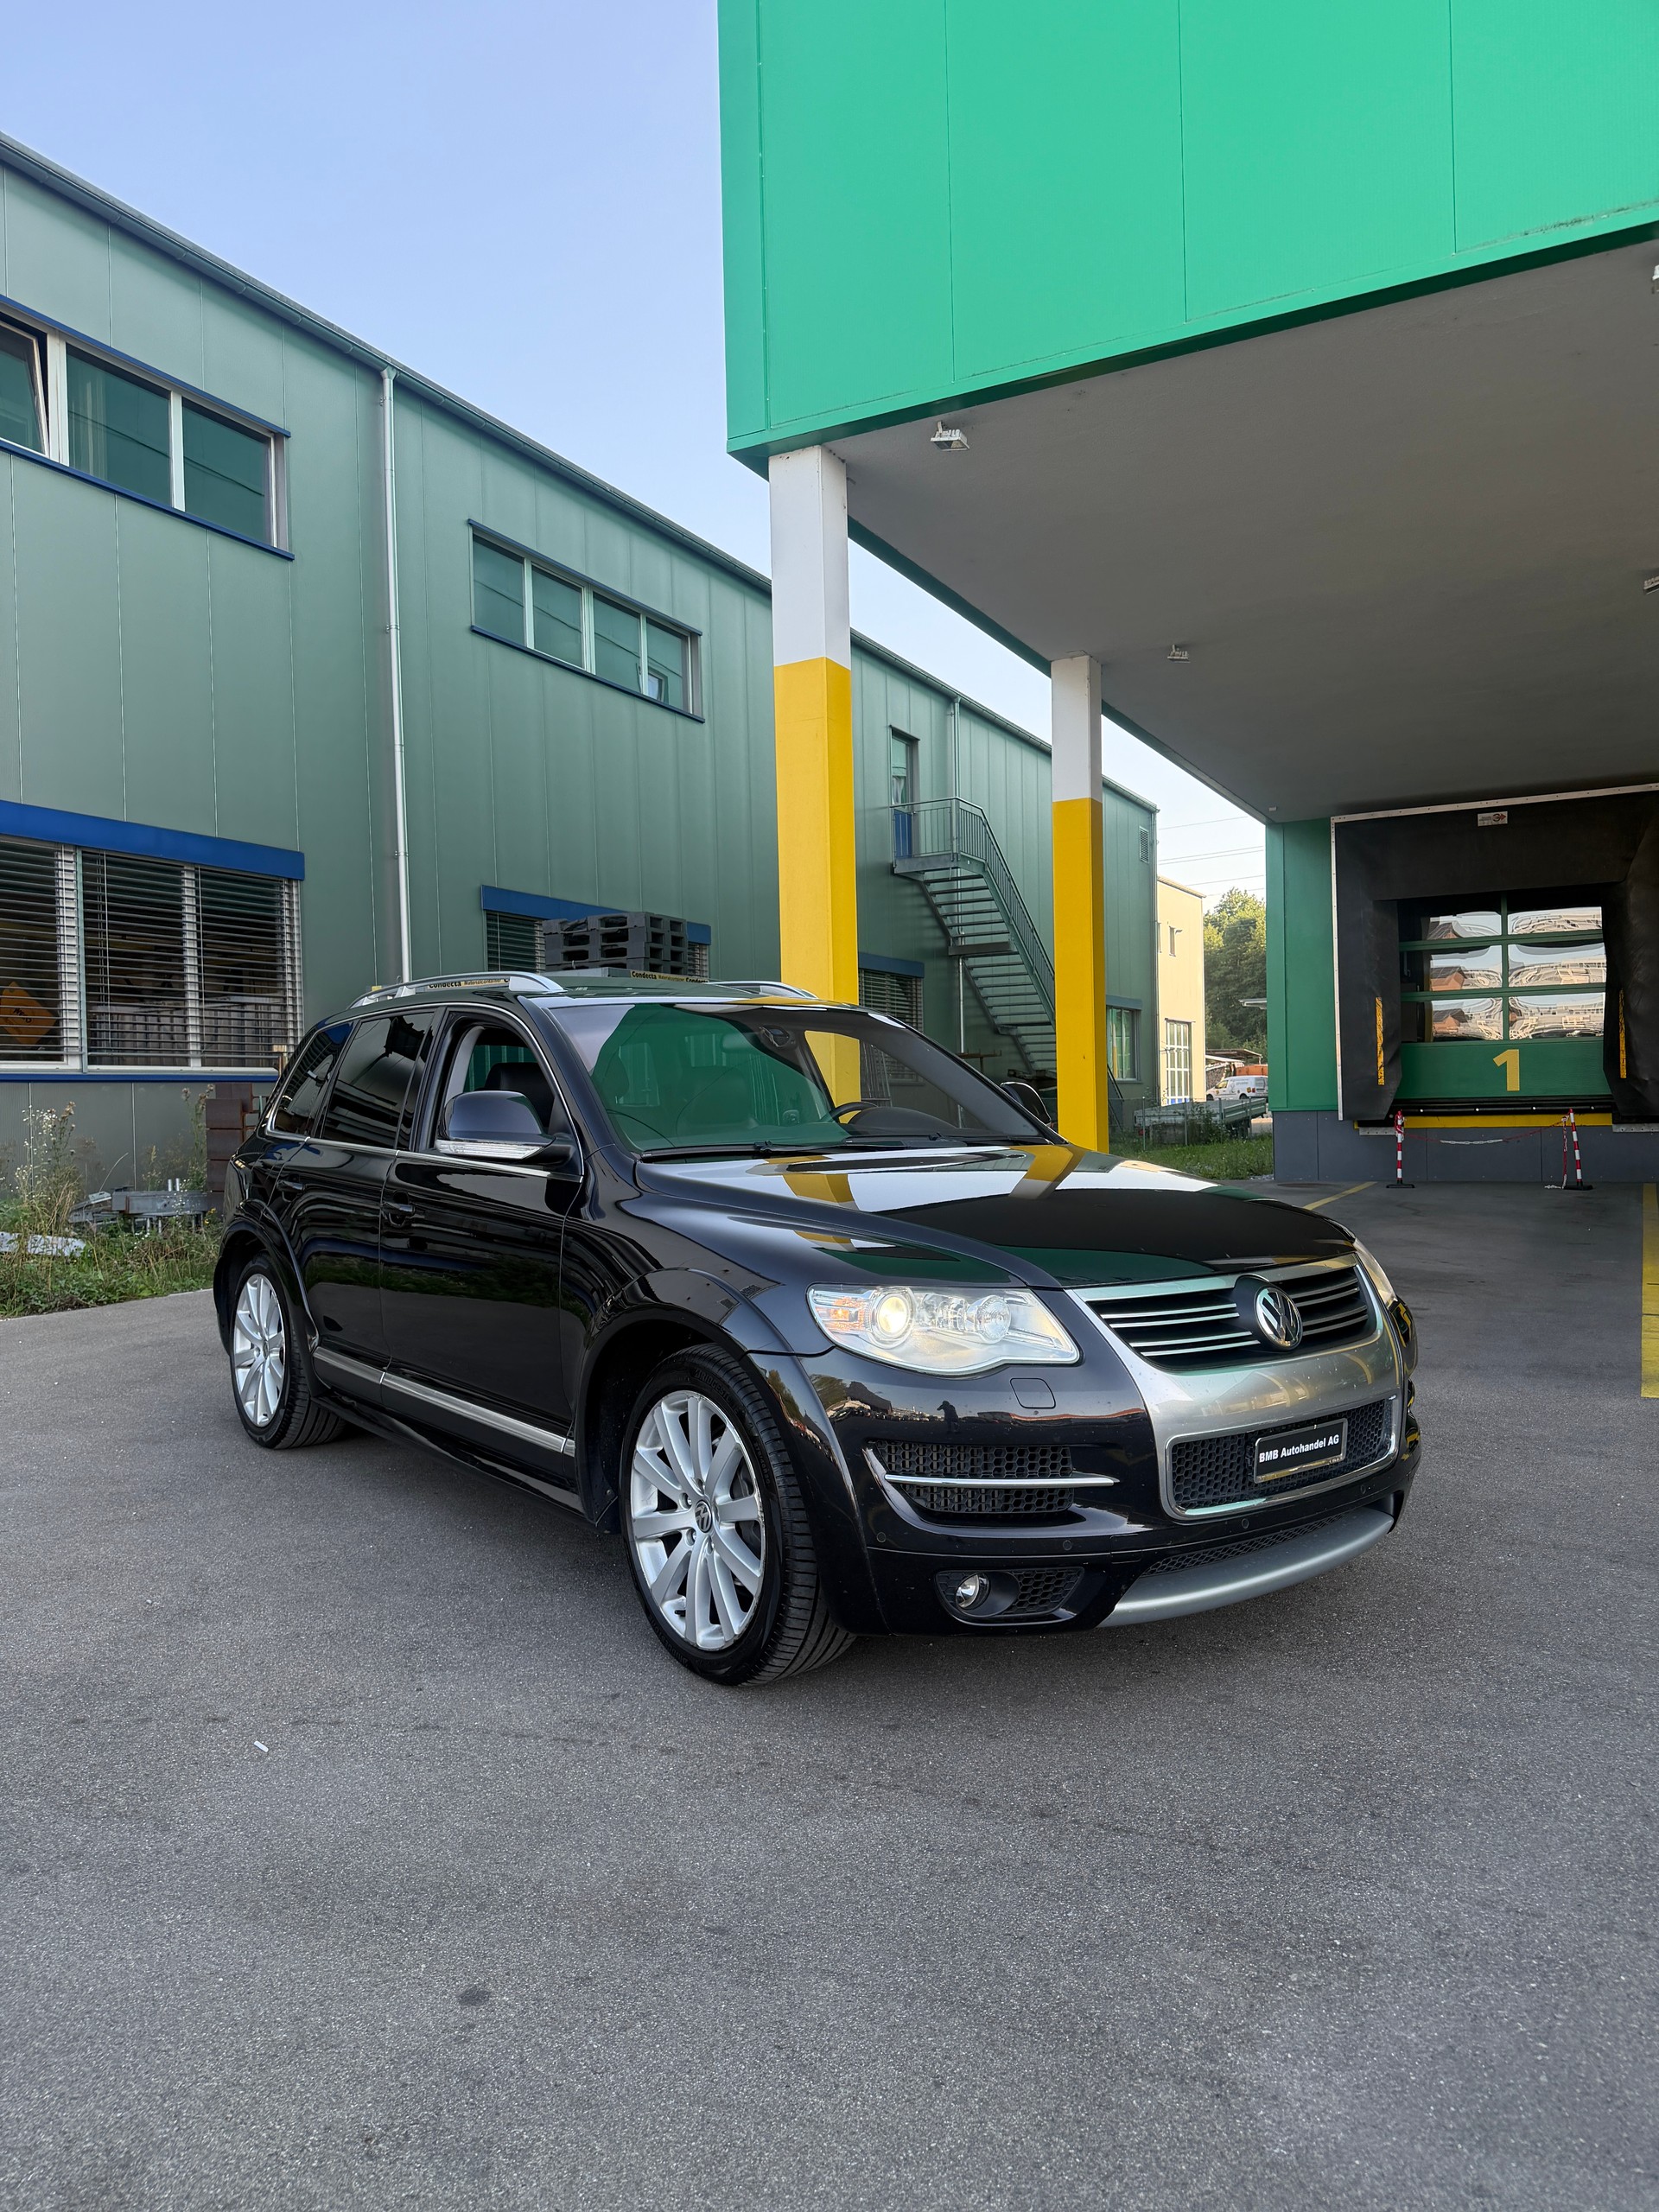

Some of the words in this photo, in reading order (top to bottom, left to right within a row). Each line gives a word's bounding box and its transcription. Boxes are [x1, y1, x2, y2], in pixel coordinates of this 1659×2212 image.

[632, 971, 657, 980] Condecta
[1493, 1049, 1520, 1091] 1
[1259, 1449, 1279, 1463] BMB
[1281, 1438, 1326, 1459] Autohandel
[1327, 1434, 1339, 1446] AG
